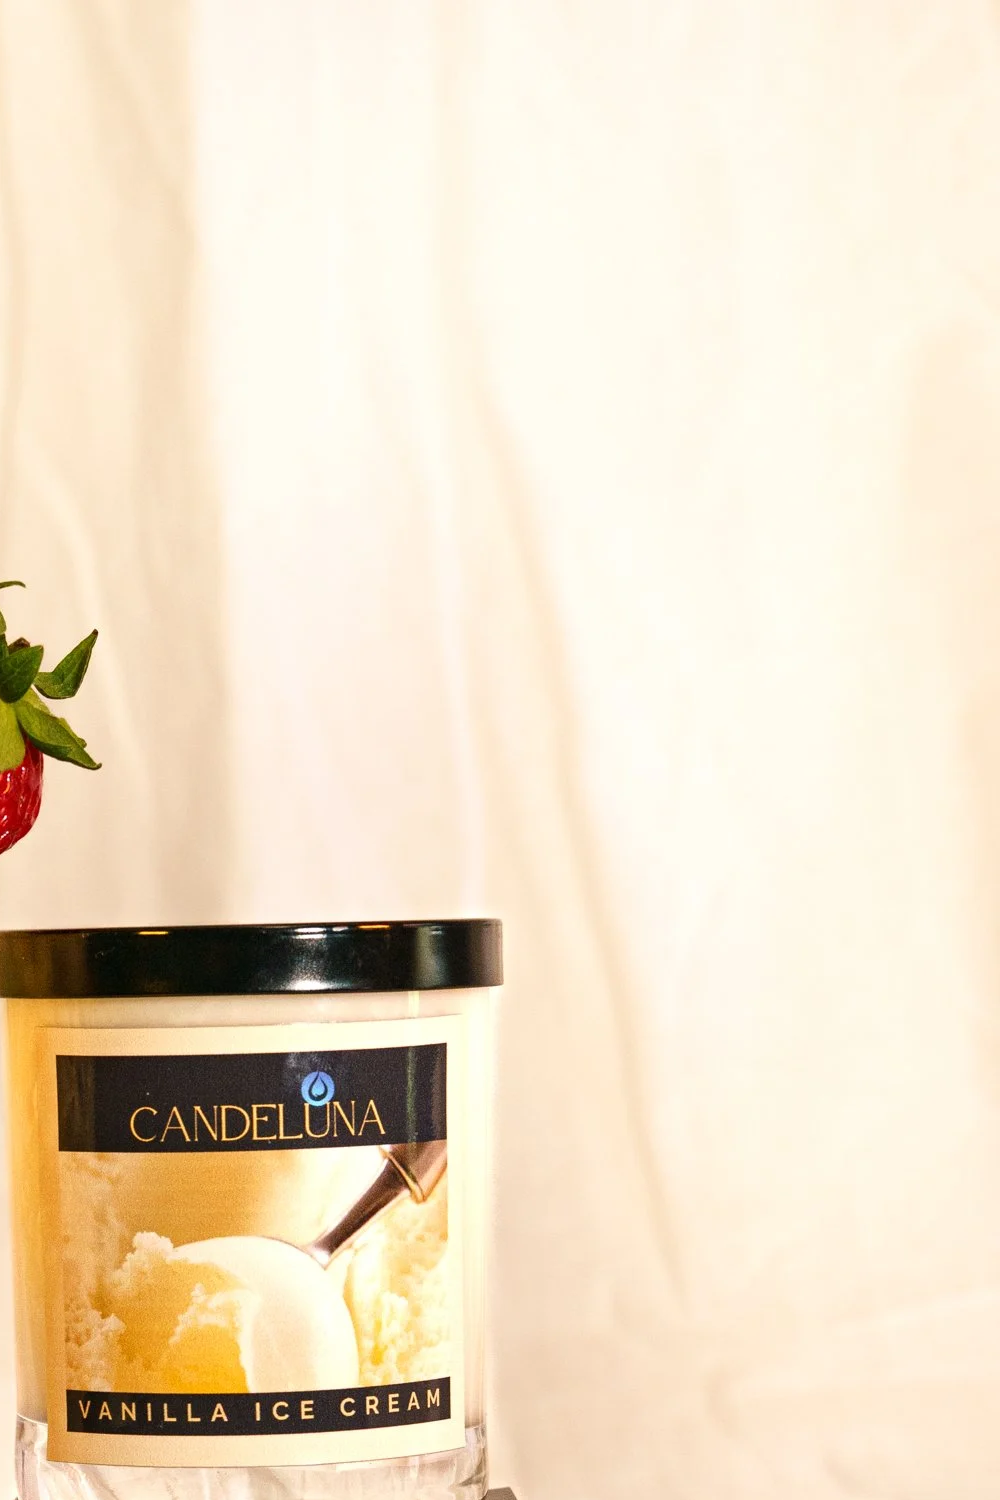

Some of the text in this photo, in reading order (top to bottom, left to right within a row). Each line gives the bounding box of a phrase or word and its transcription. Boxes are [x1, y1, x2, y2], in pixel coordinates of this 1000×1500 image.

[130, 1099, 386, 1142] CANDELUNA
[78, 1387, 442, 1423] VANILLA ICE CREAM
